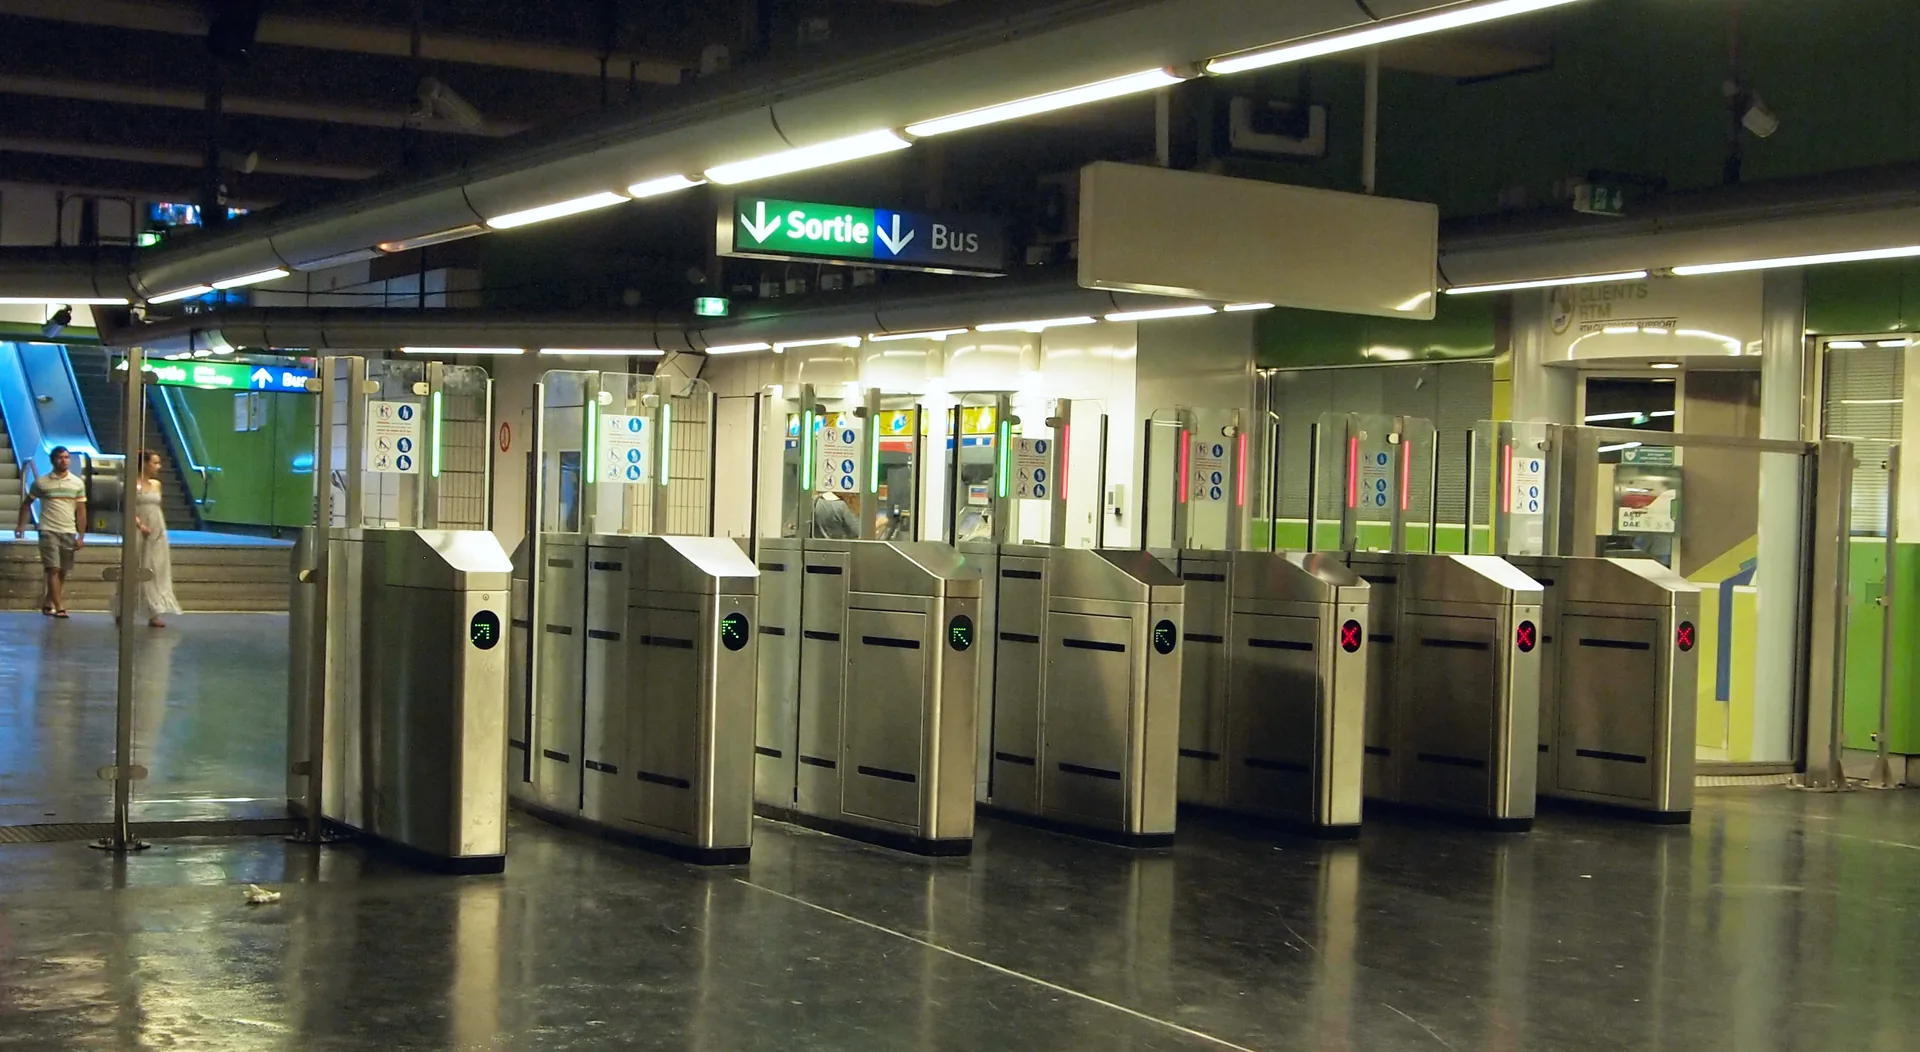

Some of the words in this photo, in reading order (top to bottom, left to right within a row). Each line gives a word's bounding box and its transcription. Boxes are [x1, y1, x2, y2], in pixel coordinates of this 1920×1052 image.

[786, 210, 869, 245] Sortie
[931, 224, 979, 253] Bus
[1579, 282, 1648, 303] CLIENTS
[1579, 302, 1611, 320] RTM
[1636, 320, 1677, 330] SUPPORT
